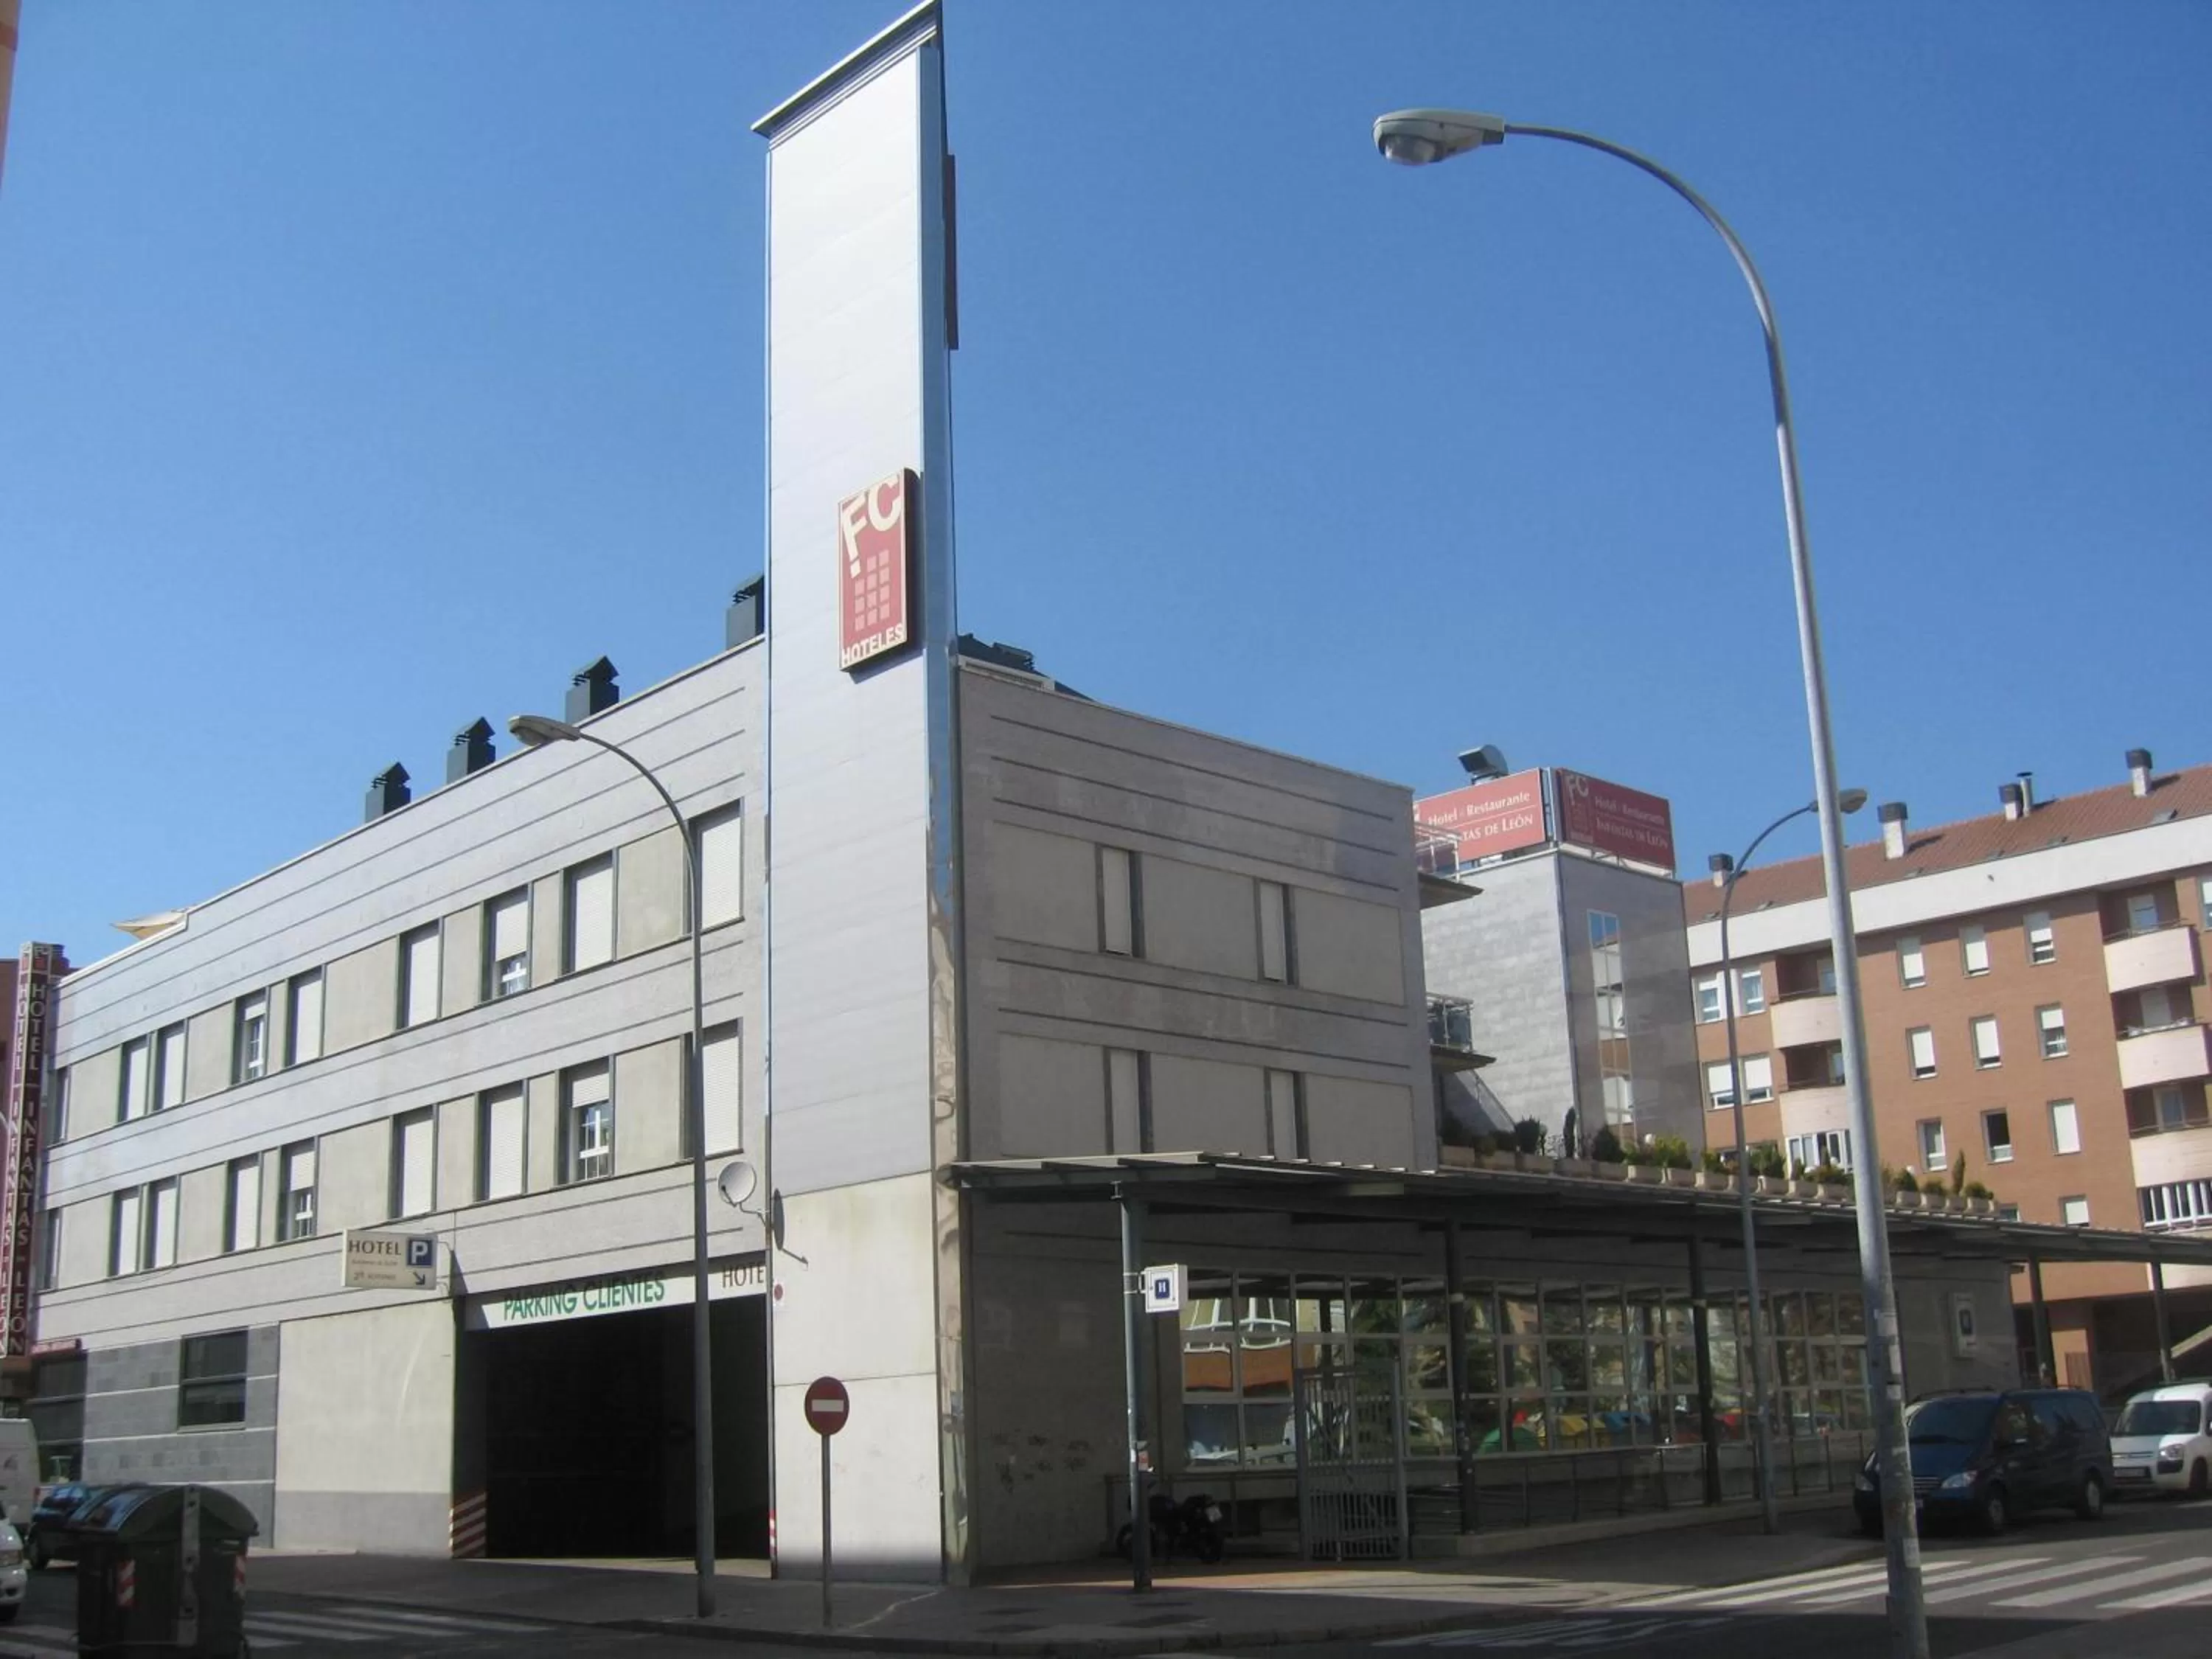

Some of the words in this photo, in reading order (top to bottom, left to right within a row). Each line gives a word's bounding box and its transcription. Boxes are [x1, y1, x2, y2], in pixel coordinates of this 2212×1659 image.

[842, 473, 902, 579] FC
[841, 623, 903, 667] HOTELES
[1427, 807, 1458, 827] Hotel
[1467, 790, 1531, 816] Restaurante
[1484, 823, 1499, 835] DE
[1502, 813, 1534, 832] LEÓN
[14, 984, 28, 1070] HOTEL
[29, 984, 47, 1071] HOTEL
[18, 1101, 36, 1246] INFANTAS
[348, 1239, 402, 1256] HOTEL
[411, 1240, 428, 1265] P
[723, 1260, 765, 1288] HOTE
[504, 1285, 578, 1321] PARKING
[582, 1273, 666, 1311] CLIENTES
[1158, 1281, 1166, 1293] H
[10, 1270, 25, 1353] LEÓN
